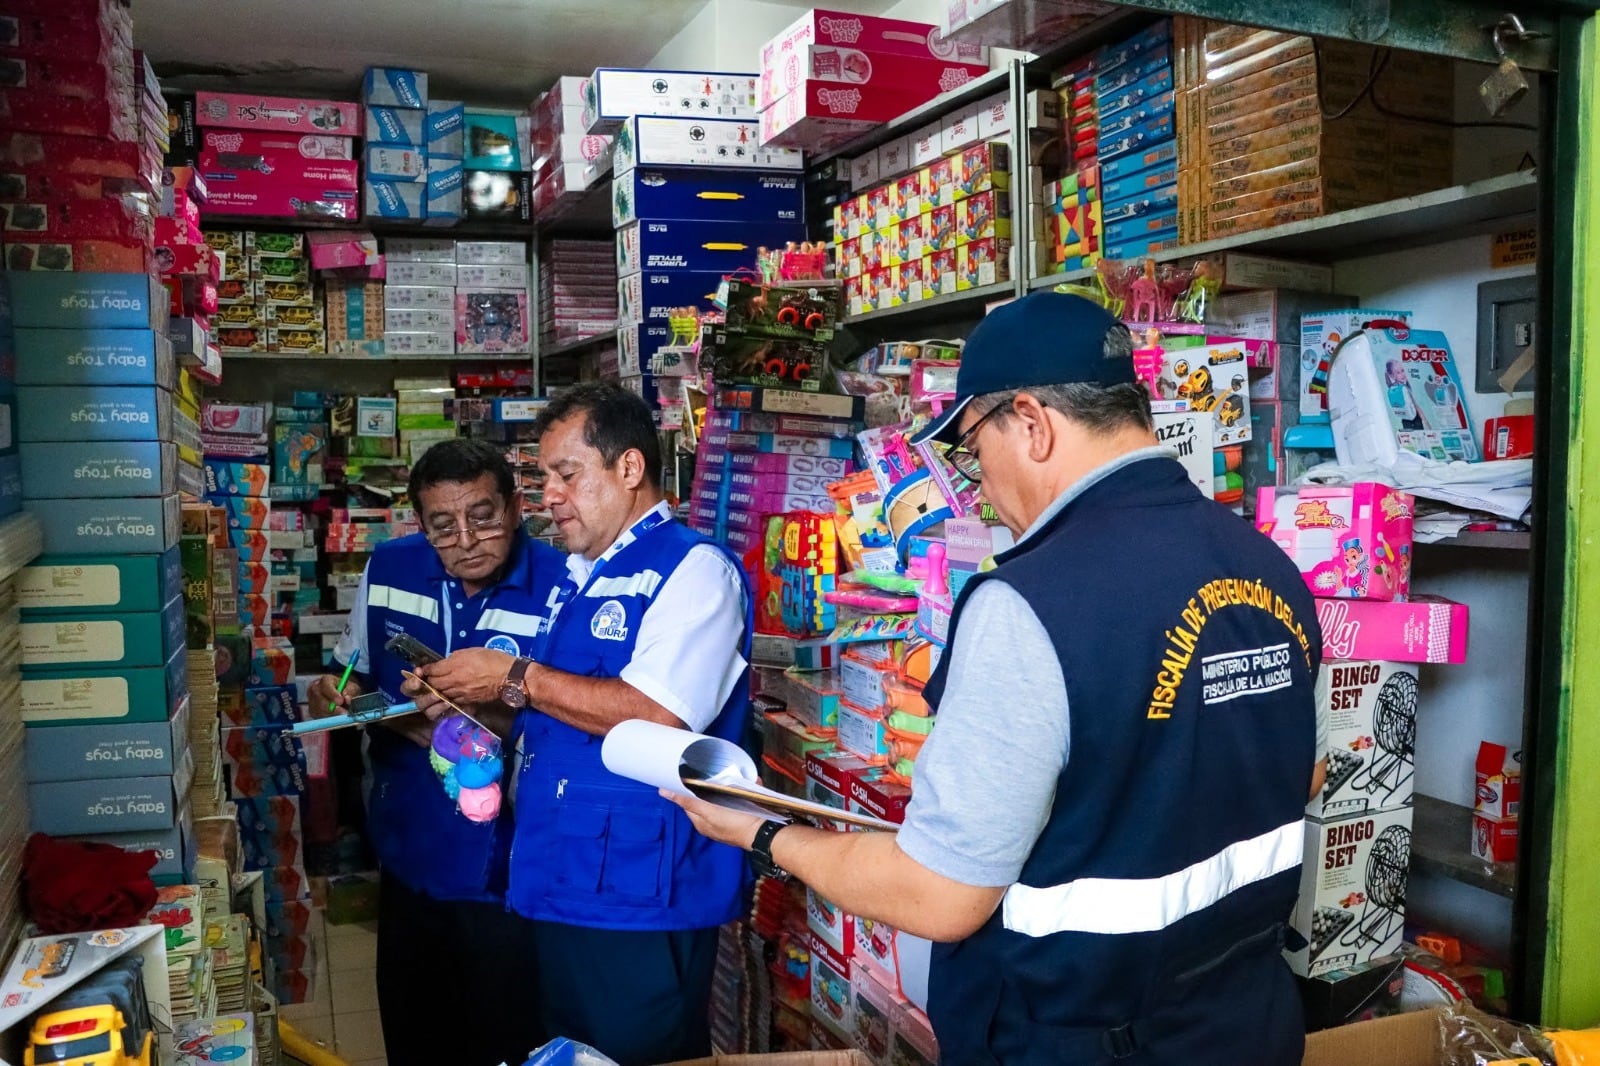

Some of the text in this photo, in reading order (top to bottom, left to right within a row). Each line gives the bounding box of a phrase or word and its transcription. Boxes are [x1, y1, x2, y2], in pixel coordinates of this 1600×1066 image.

[819, 16, 864, 35] Sweet
[830, 29, 860, 44] Baby
[942, 68, 970, 82] Baby
[816, 88, 862, 106] Sweet
[829, 100, 859, 115] Baby
[303, 172, 327, 180] Home
[234, 192, 258, 201] Home
[61, 296, 141, 310] Baby Toys
[67, 352, 146, 368] Baby Toys
[1402, 349, 1450, 363] DOCTOR
[70, 410, 150, 424] Baby Toys
[74, 466, 152, 479] Baby Toys
[205, 465, 216, 492] Bingo
[77, 522, 156, 536] Baby Toys
[948, 525, 969, 535] HAPPY
[1147, 626, 1198, 720] FISCALÍA
[1180, 598, 1207, 635] DE
[1198, 578, 1272, 616] PREVENCIÓN
[1274, 594, 1297, 635] DEL
[1202, 648, 1290, 680] MINISTERIO PÚBLICO
[1203, 665, 1292, 700] FISCALÍA DE LA NACIÓN
[1332, 664, 1380, 688] BINGO
[280, 690, 296, 721] Bingo
[1330, 688, 1362, 710] SET
[86, 746, 164, 762] Baby Toys
[807, 758, 824, 778] CASH
[290, 763, 304, 792] Bingo
[851, 782, 868, 802] CASH
[88, 801, 166, 816] Baby Toys
[1327, 820, 1374, 848] BINGO
[1325, 845, 1357, 870] SET
[811, 936, 828, 958] CASH
